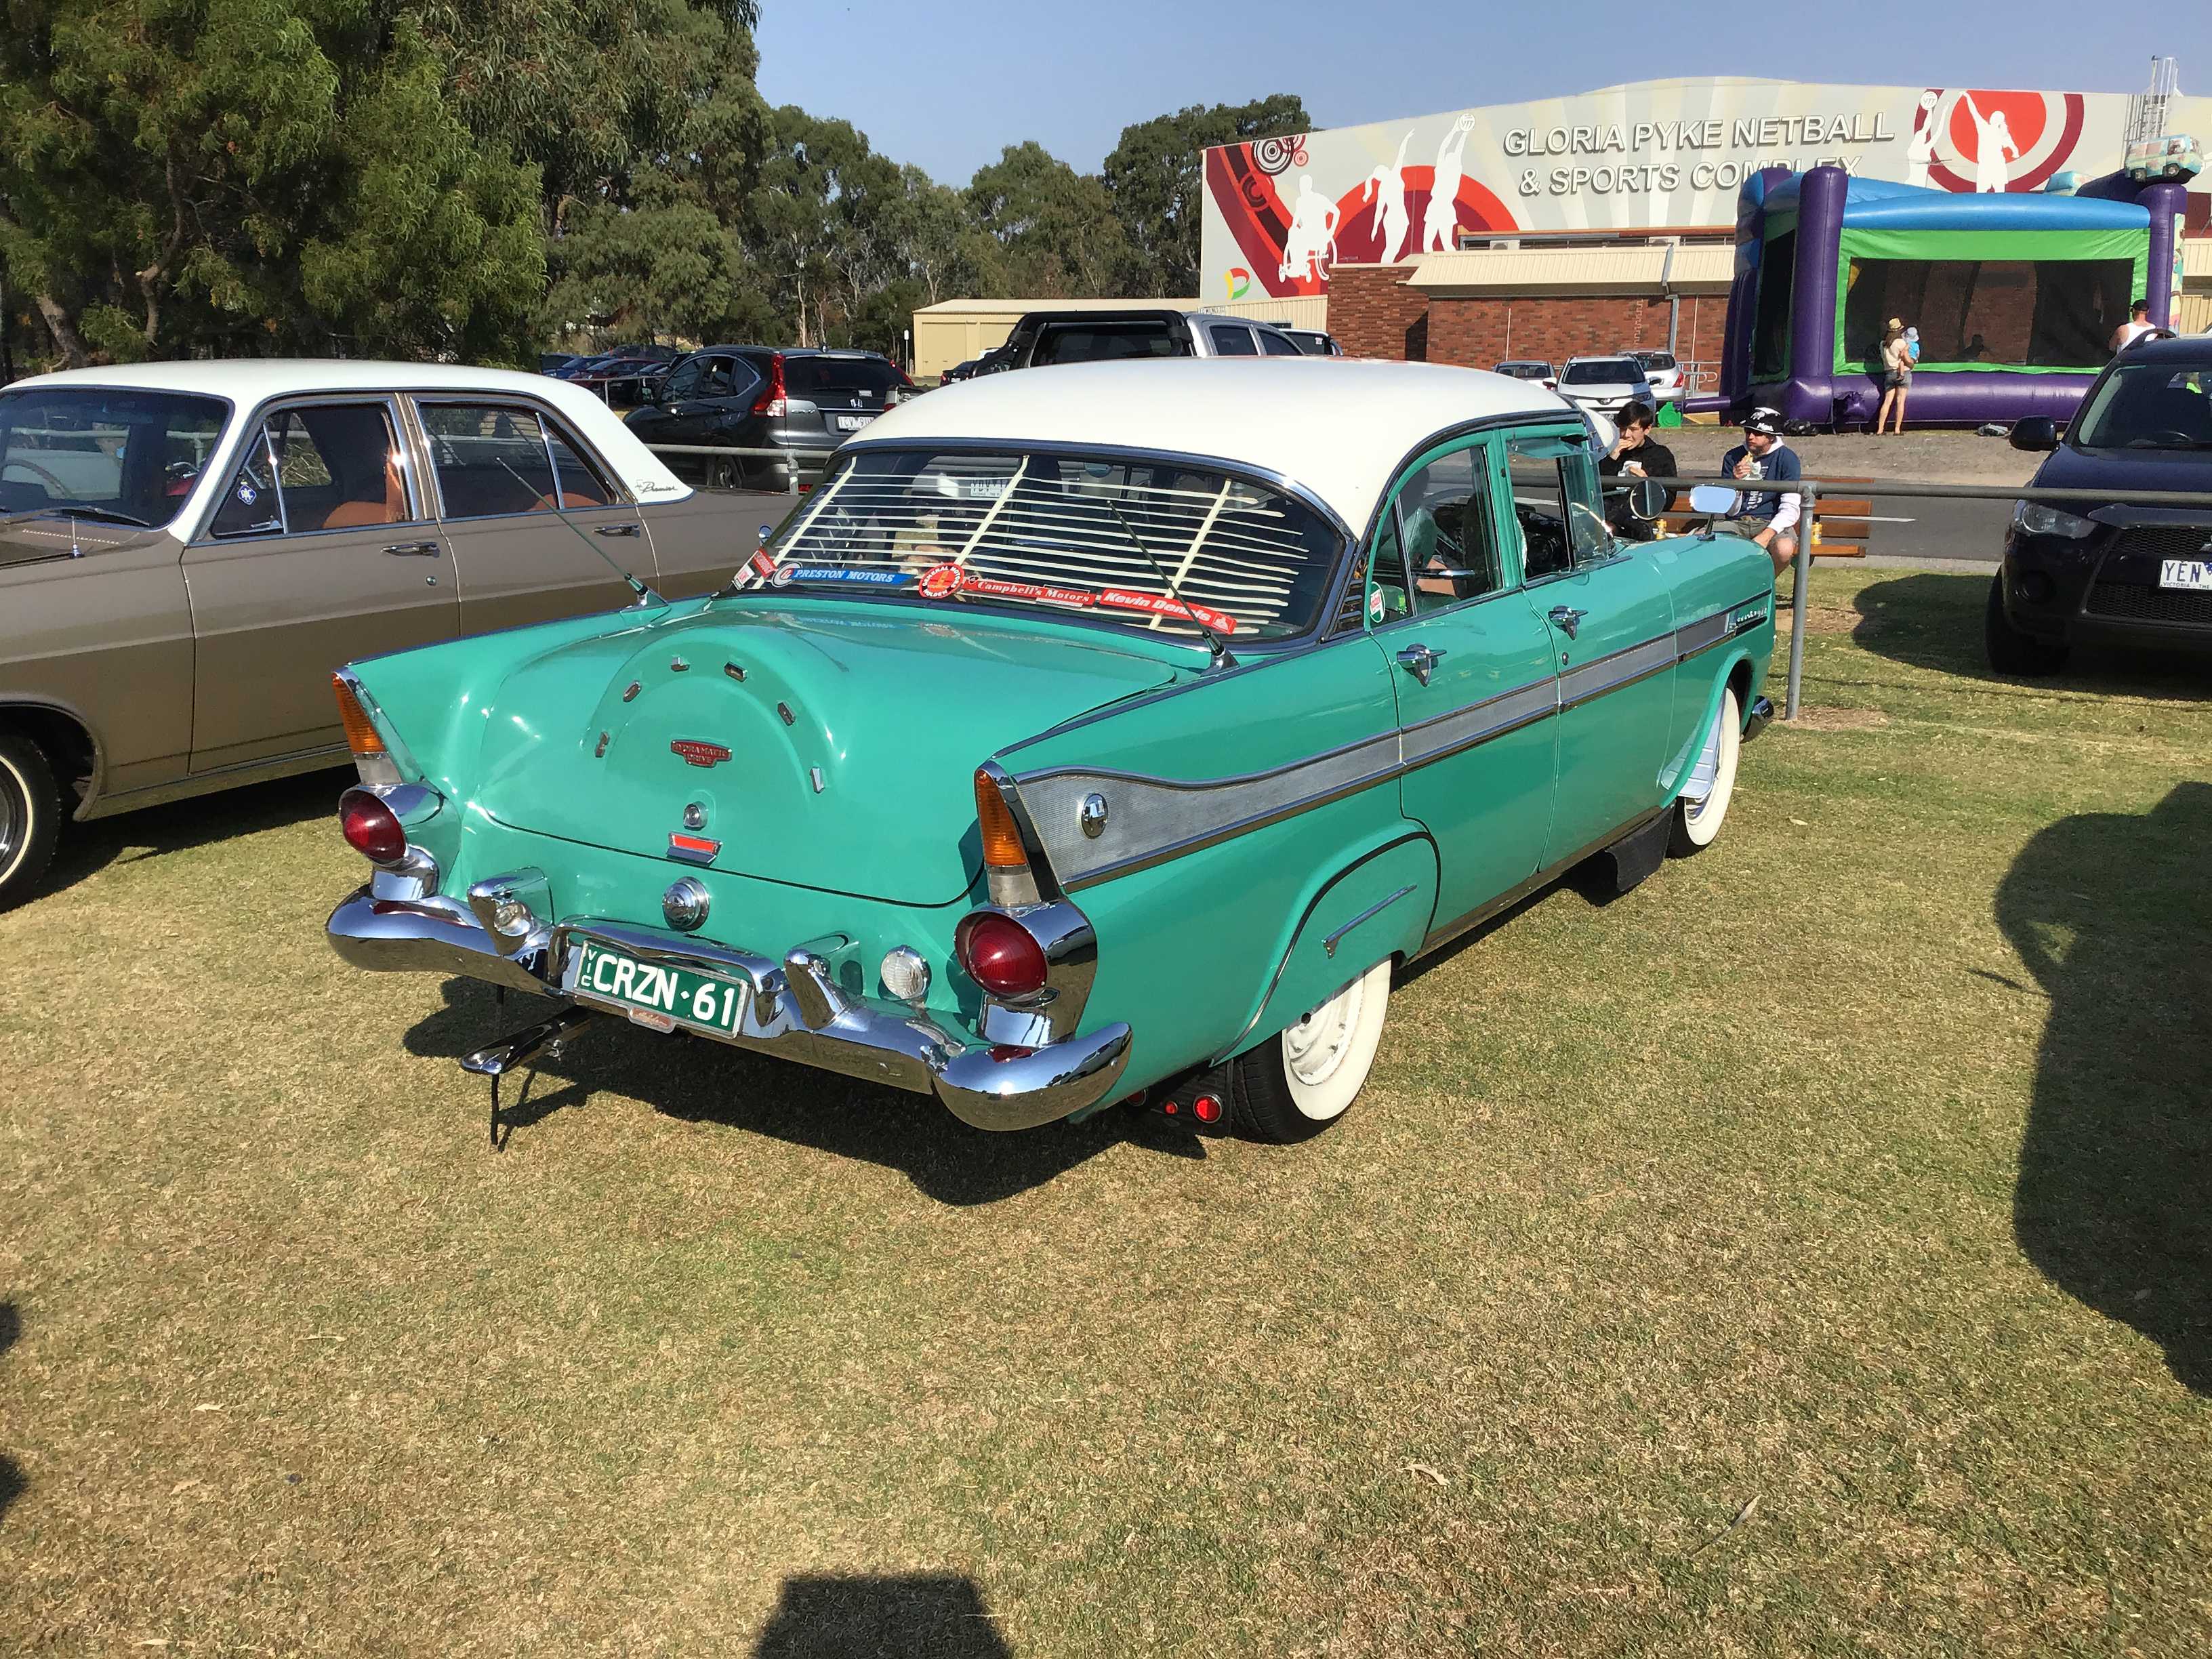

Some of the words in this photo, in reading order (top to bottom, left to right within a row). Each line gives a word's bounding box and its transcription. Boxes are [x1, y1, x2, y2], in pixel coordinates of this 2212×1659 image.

[1503, 123, 1625, 157] GLORIA
[1633, 119, 1723, 152] PYKE
[1732, 112, 1895, 148] NETBALL
[1519, 168, 1540, 197] &
[1549, 163, 1681, 195] SPORTS
[794, 569, 845, 579] PRESTON
[846, 570, 895, 583] MOTORS
[922, 565, 949, 587] GENERAL
[950, 566, 961, 588] MOTORS
[2165, 561, 2202, 583] YEN
[923, 589, 948, 597] HOLDEN
[977, 581, 1042, 596] Campbell's
[1045, 589, 1090, 602] Motors
[1105, 592, 1151, 607] Kevin
